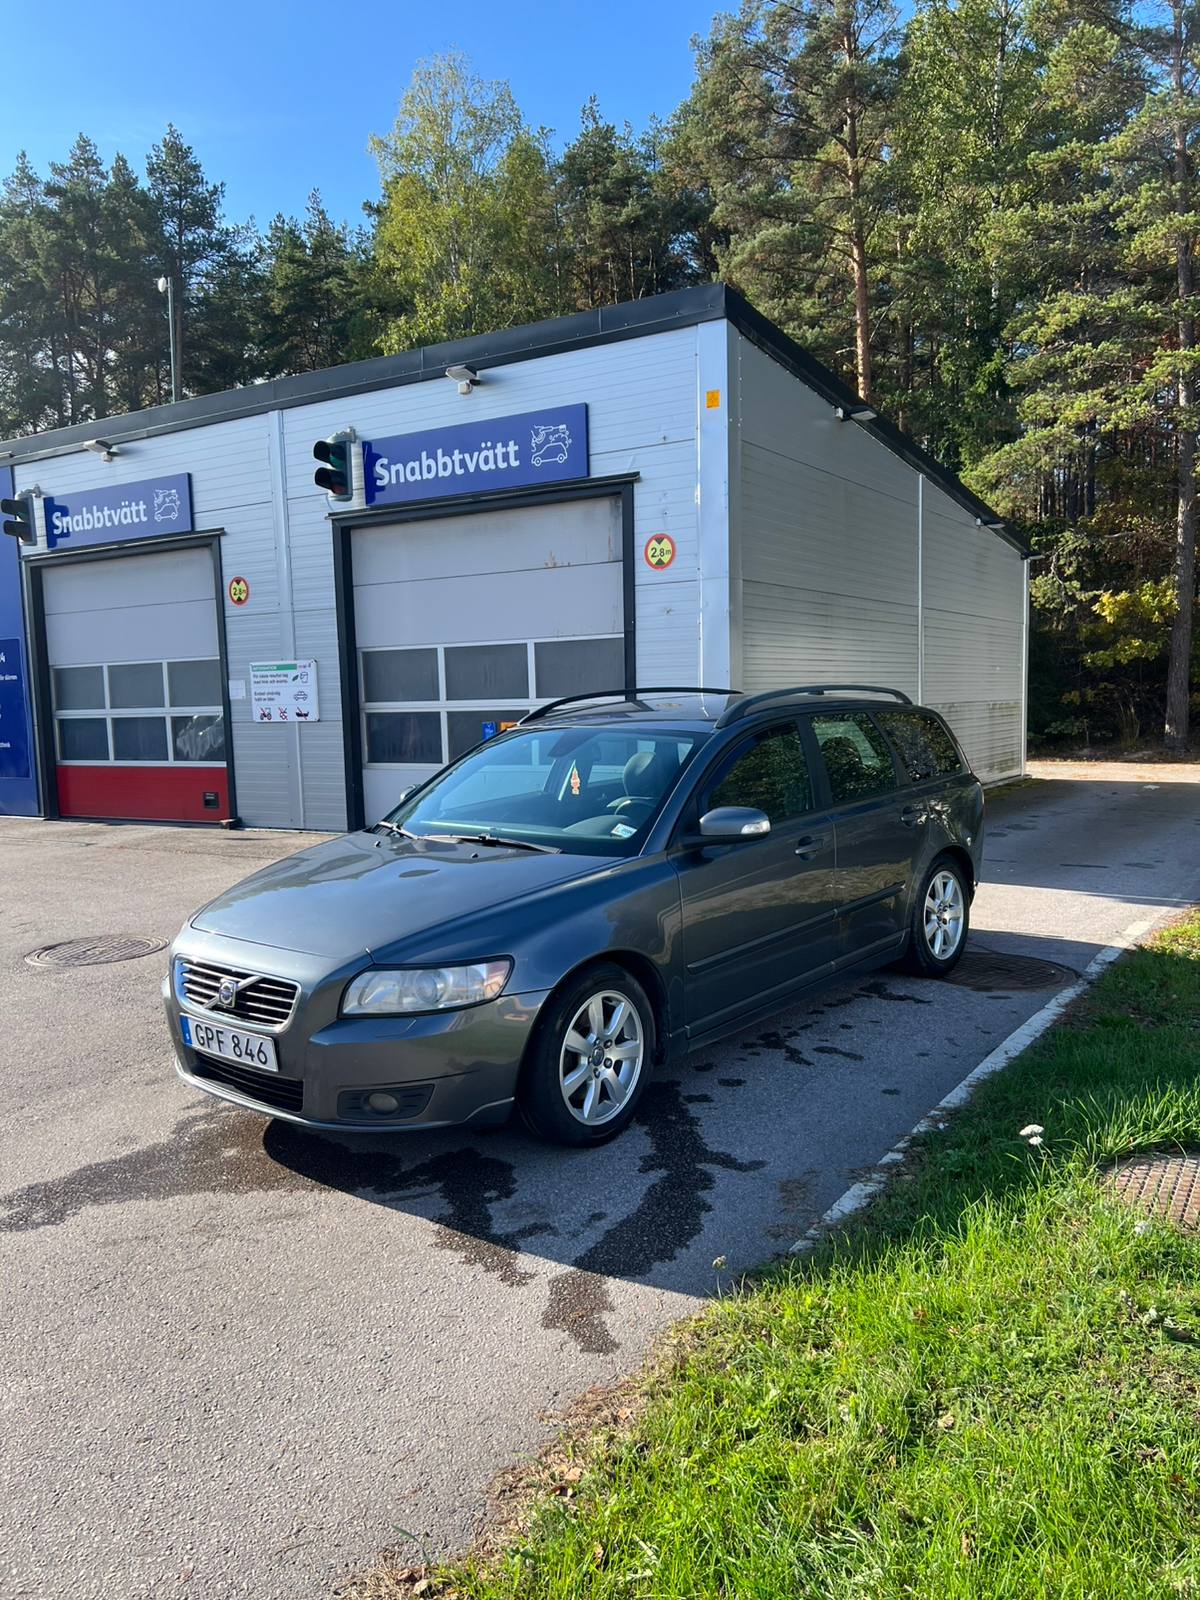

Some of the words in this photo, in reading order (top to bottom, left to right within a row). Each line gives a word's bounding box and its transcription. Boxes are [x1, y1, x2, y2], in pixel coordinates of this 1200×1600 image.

[375, 441, 520, 487] Snabbtvätt
[52, 500, 148, 535] Snabbtvätt
[195, 1023, 225, 1053] GPF
[231, 1034, 268, 1066] 846
